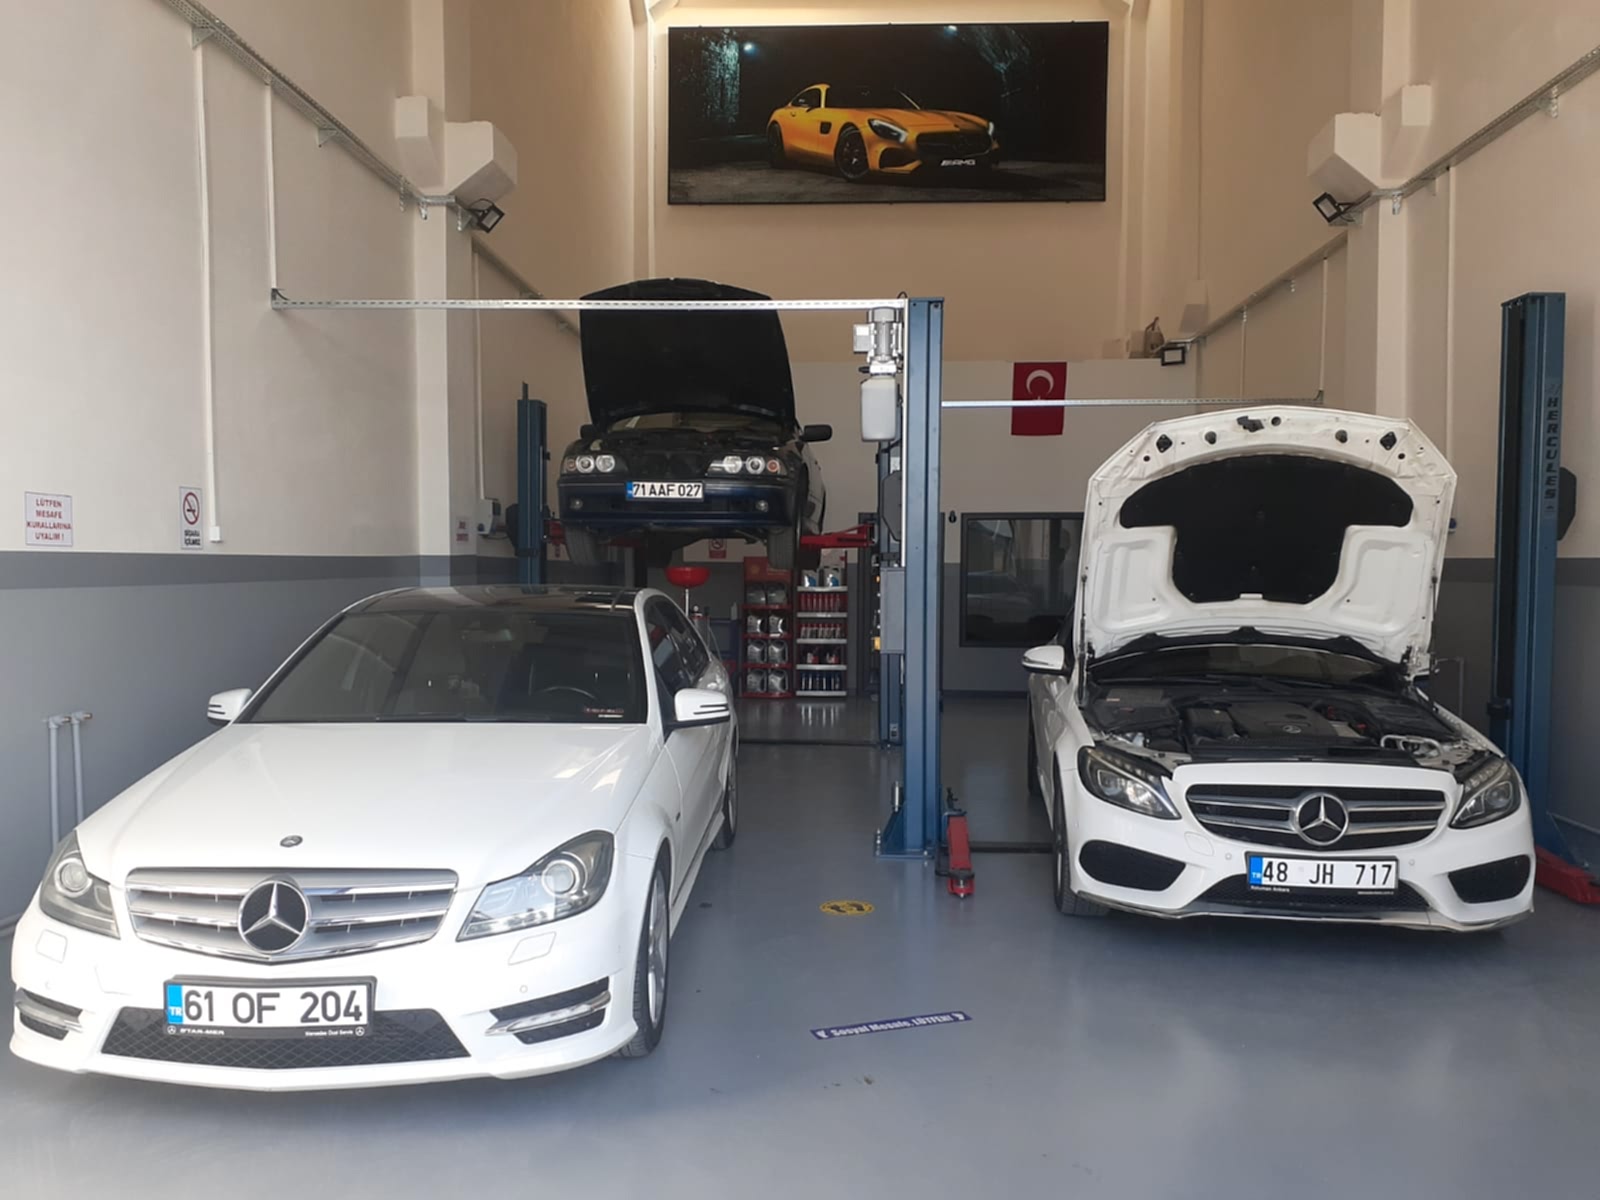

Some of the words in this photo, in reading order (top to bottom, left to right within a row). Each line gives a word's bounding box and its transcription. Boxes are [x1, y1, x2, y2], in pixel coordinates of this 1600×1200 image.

[1544, 397, 1559, 500] HERCULES
[633, 483, 646, 496] 71
[649, 484, 675, 497] AAF
[678, 484, 701, 497] 027
[36, 498, 62, 508] LÜTFEN
[36, 509, 62, 519] MESAFE
[27, 521, 72, 531] KURALLARINA
[1263, 861, 1288, 882] 48
[1309, 863, 1334, 885] JH
[1355, 864, 1392, 885] 717
[169, 1006, 183, 1017] TR
[184, 990, 214, 1022] 61
[232, 992, 280, 1024] OF
[300, 990, 363, 1024] 204
